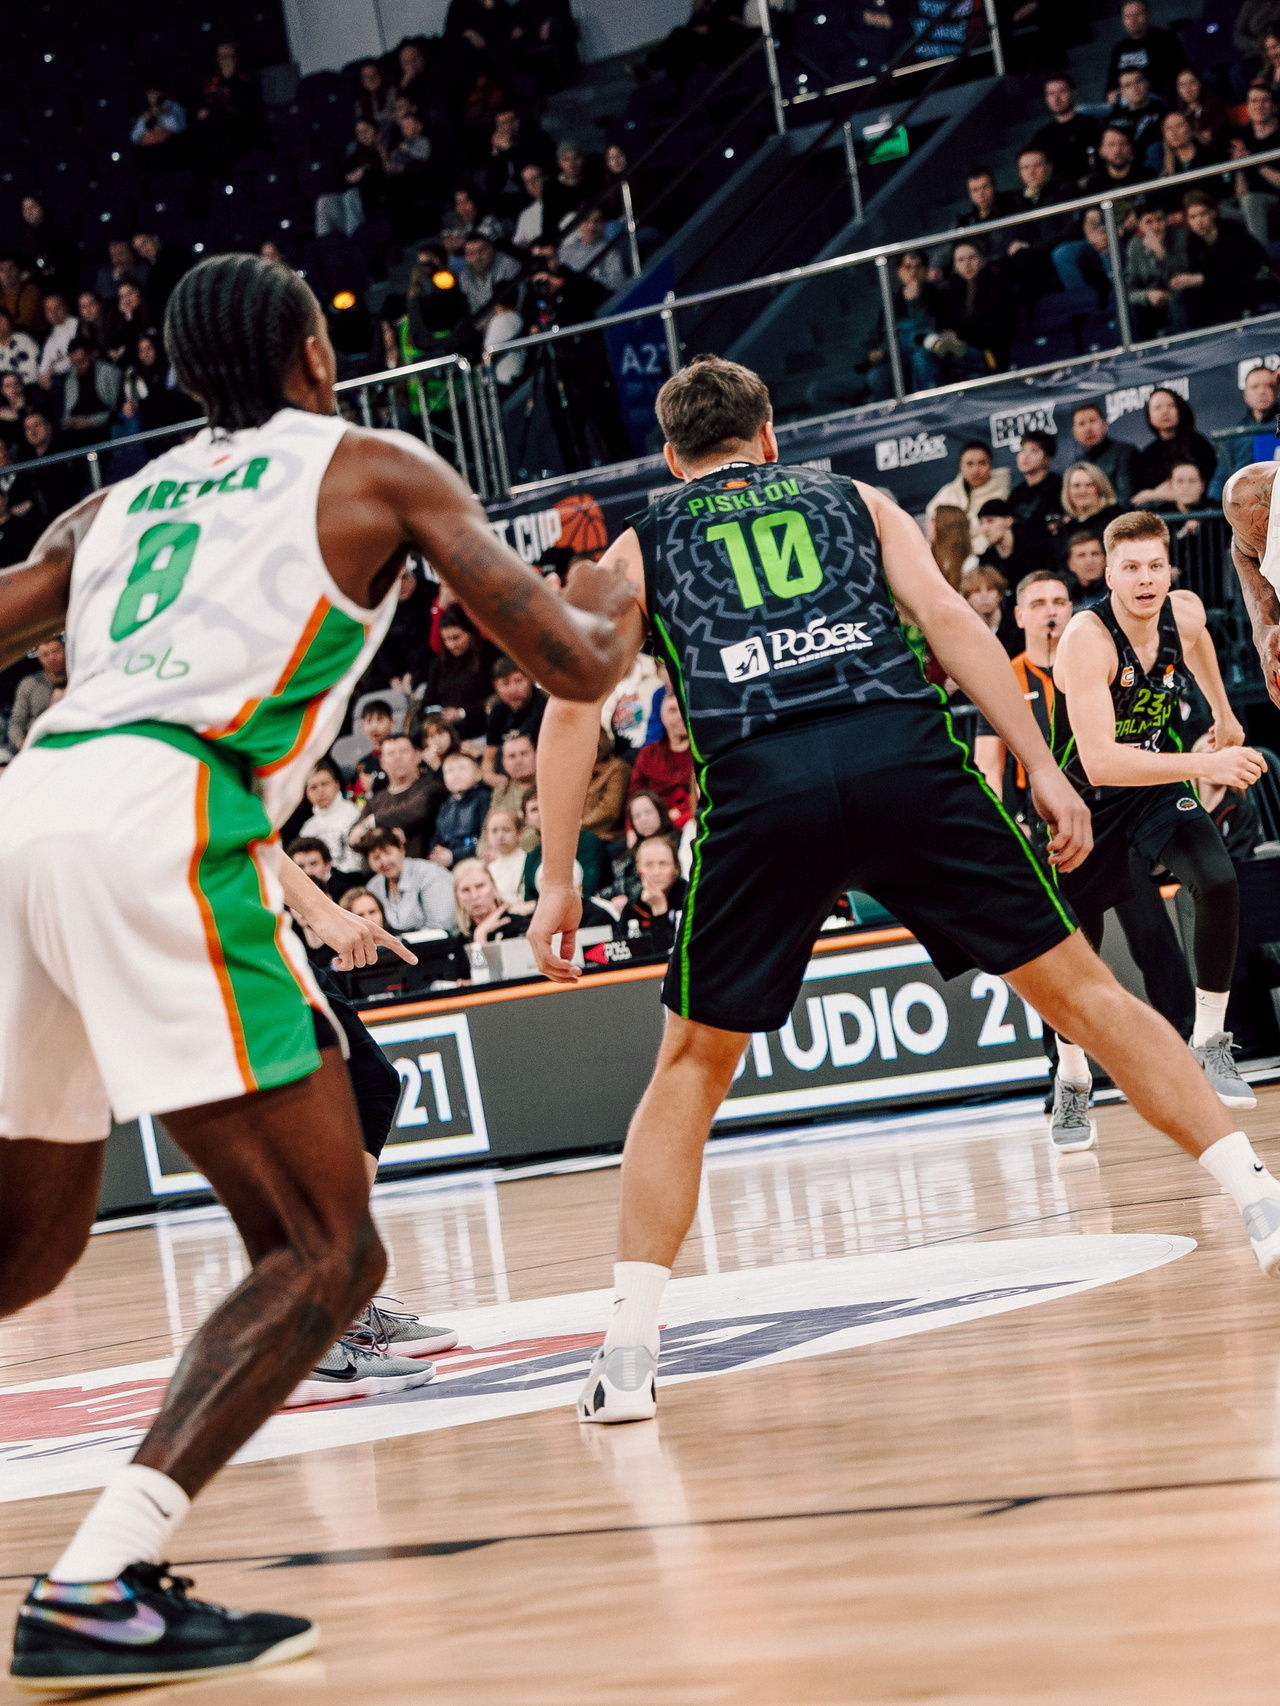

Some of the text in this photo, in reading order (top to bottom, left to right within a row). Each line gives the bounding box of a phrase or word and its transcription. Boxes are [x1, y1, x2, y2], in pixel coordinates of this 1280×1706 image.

[688, 479, 800, 518] PISKLOV
[110, 522, 200, 642] 8
[706, 510, 824, 609] 10
[766, 616, 873, 661] Робек
[1132, 688, 1166, 716] 23
[731, 981, 949, 1081] UDIO
[392, 1051, 453, 1129] 21
